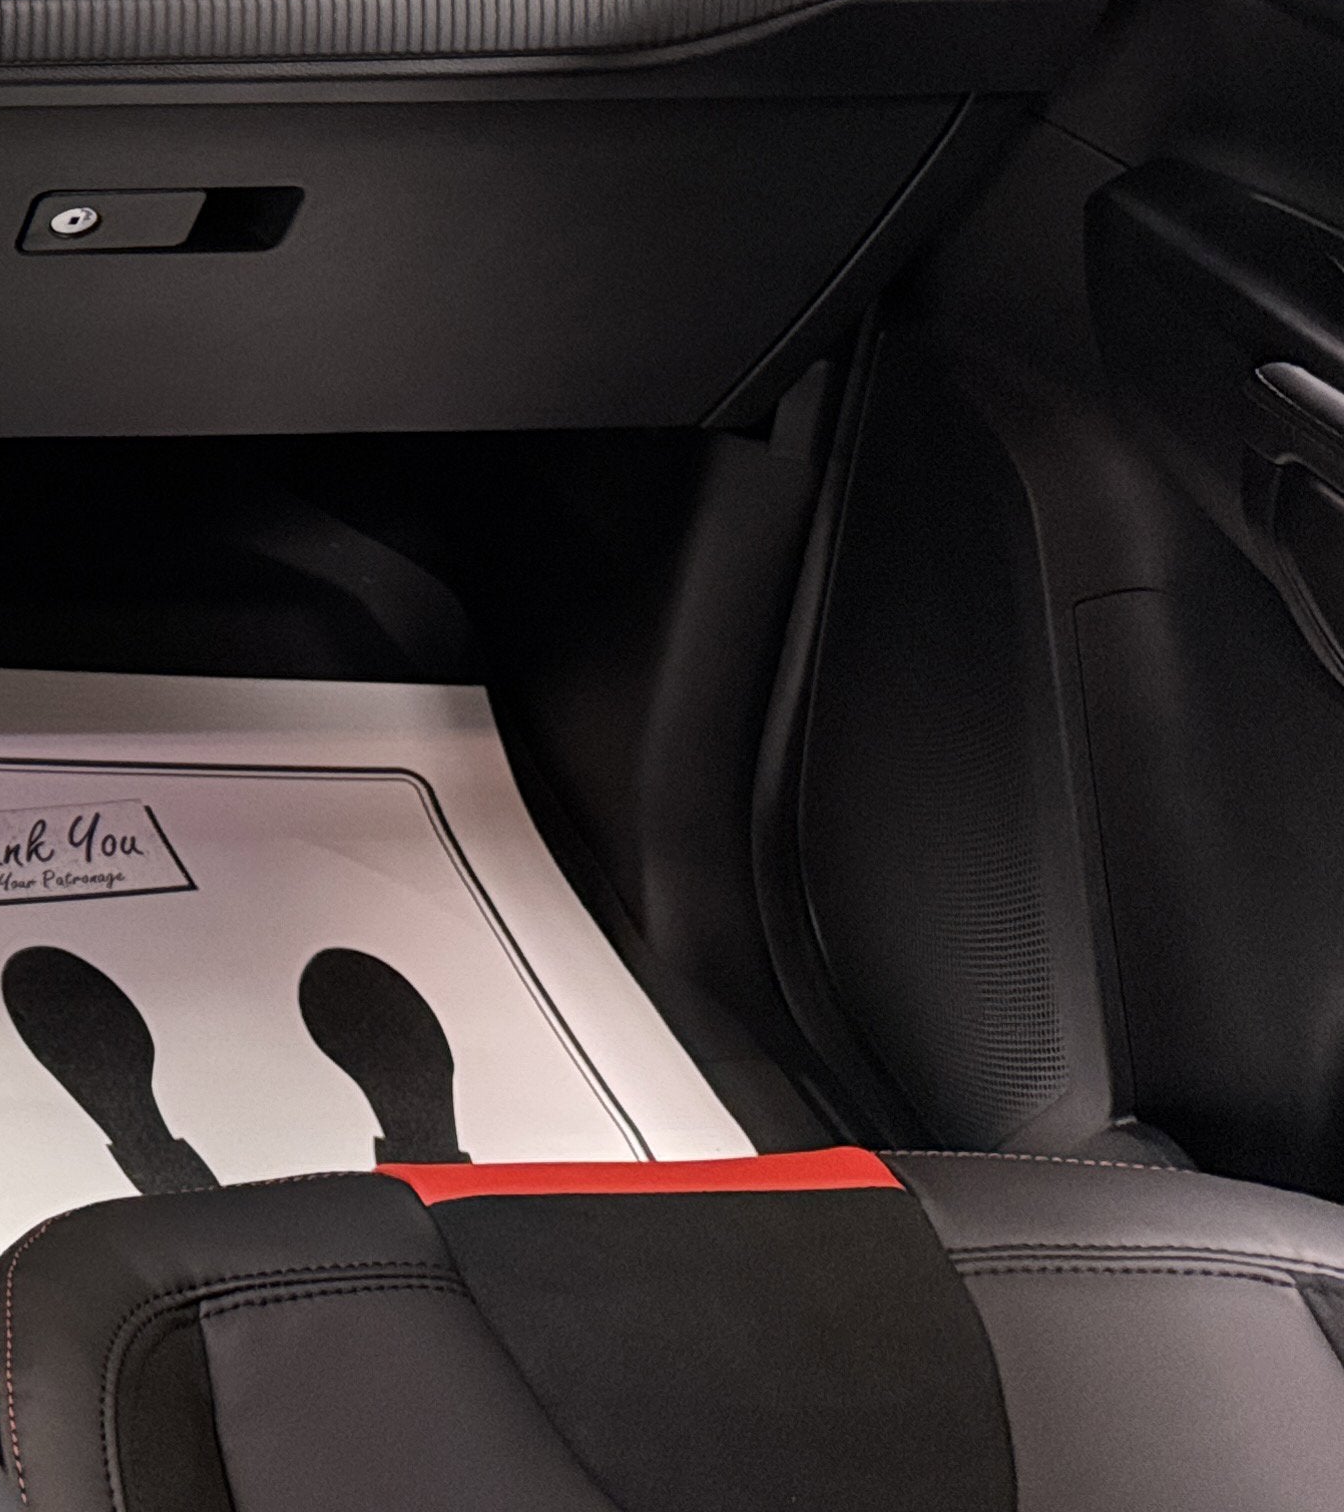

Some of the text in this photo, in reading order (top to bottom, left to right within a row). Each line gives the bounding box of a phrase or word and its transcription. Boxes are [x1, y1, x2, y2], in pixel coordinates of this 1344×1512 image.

[67, 812, 145, 863] You
[0, 871, 37, 891] Your
[42, 868, 126, 891] Patronage
